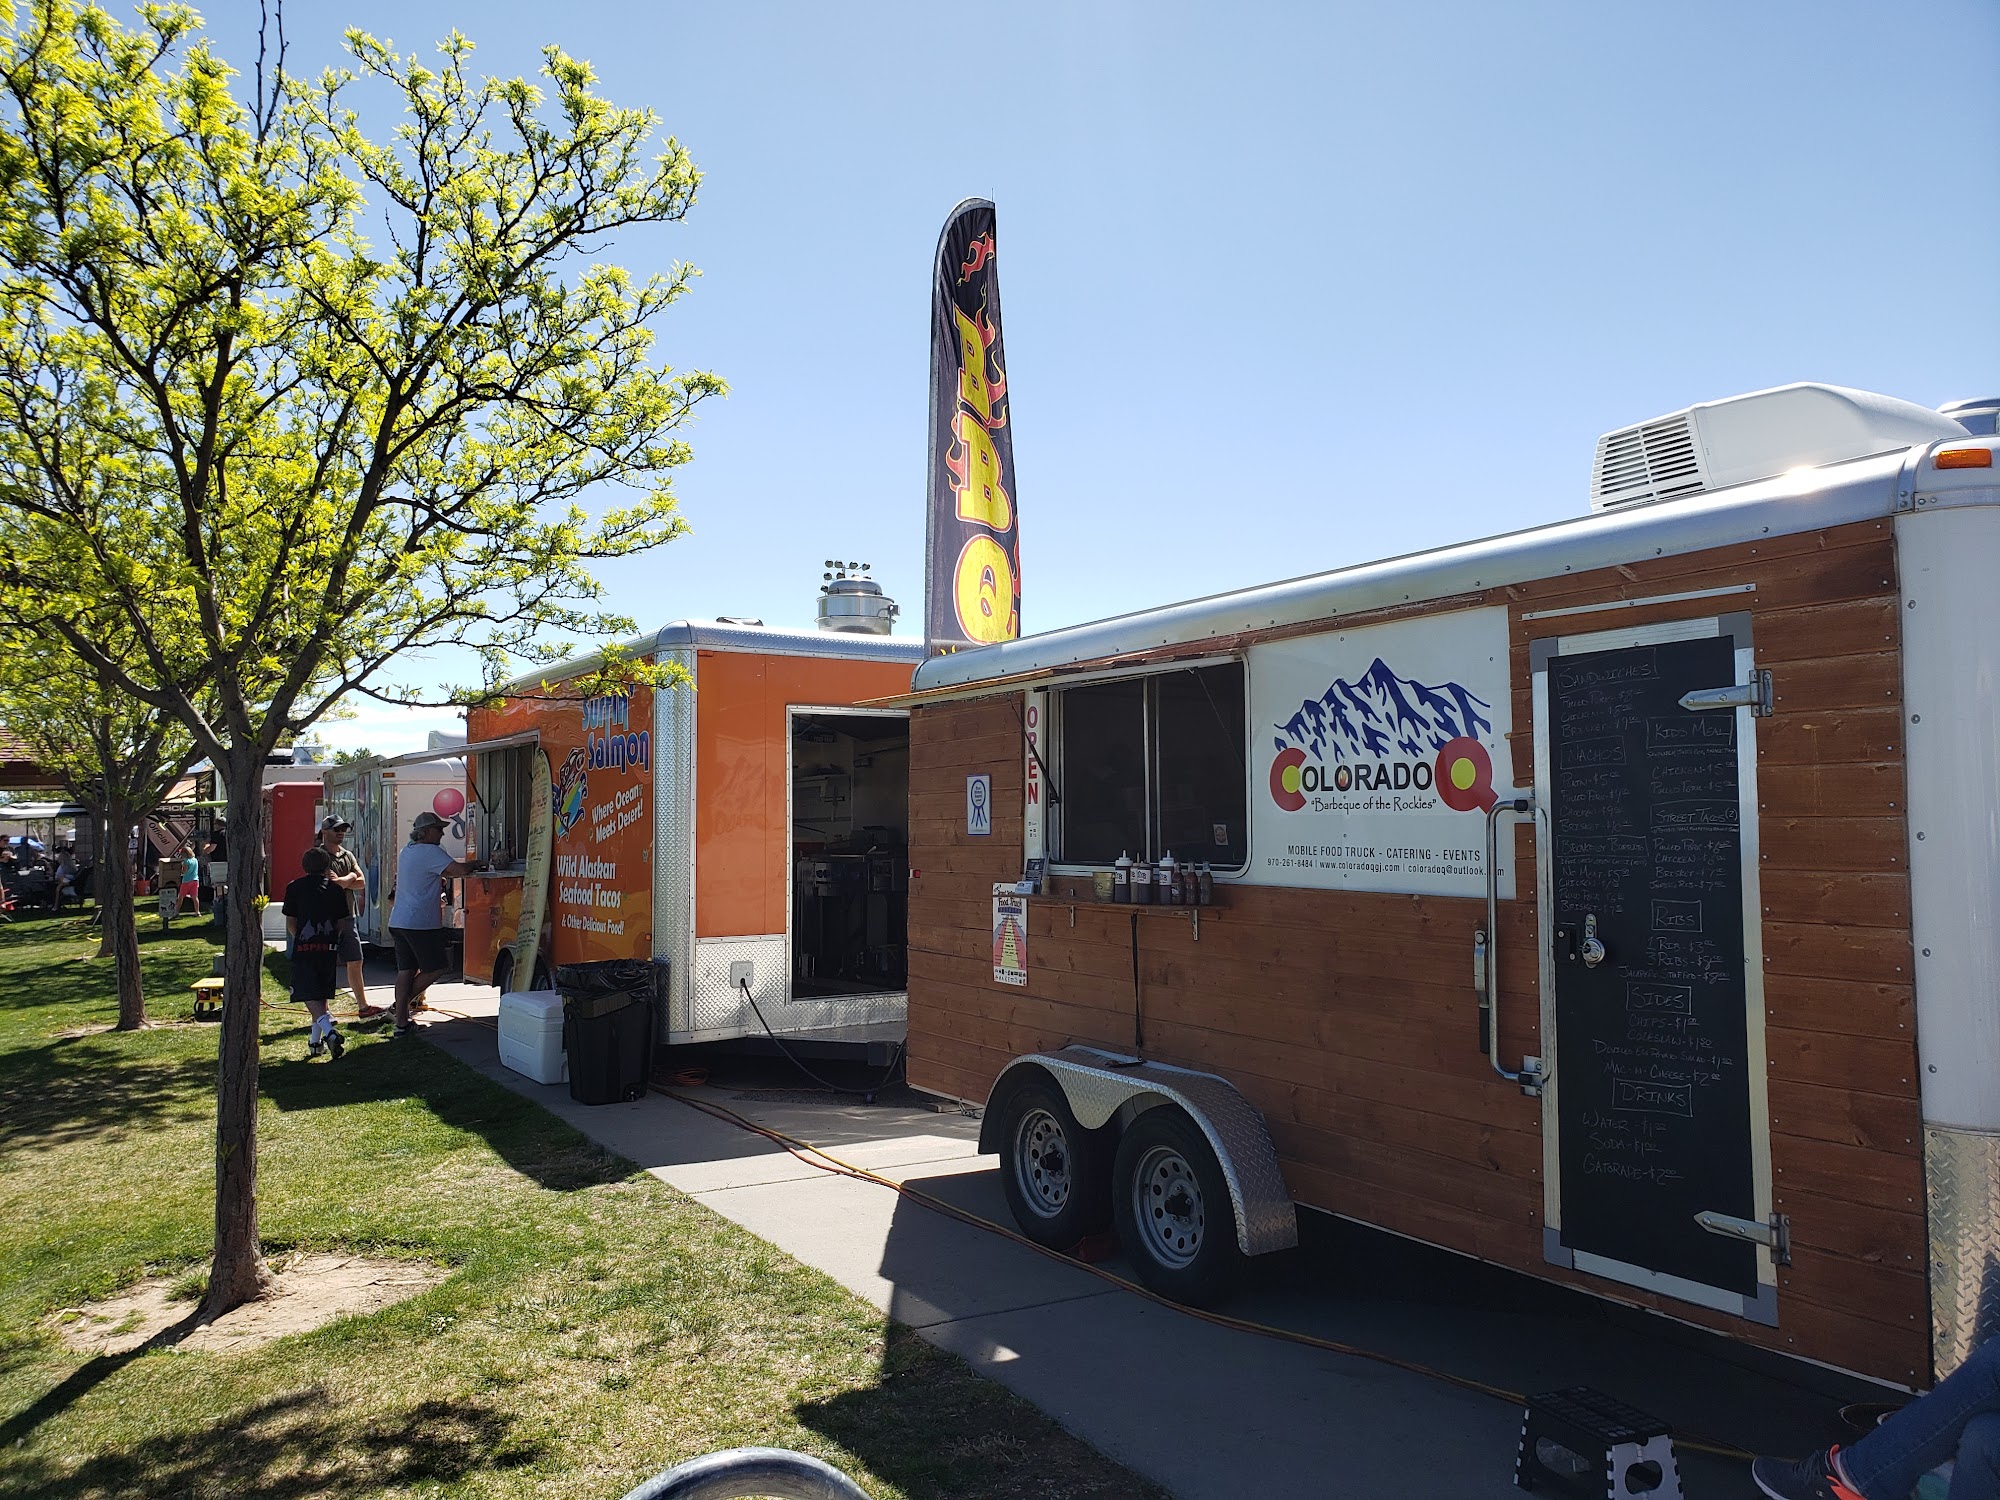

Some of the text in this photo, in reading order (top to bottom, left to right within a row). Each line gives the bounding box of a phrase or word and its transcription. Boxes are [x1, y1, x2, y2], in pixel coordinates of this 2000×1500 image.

[953, 302, 1018, 648] BBQ
[588, 730, 650, 775] Salmon
[1027, 706, 1038, 804] OPEN
[592, 784, 639, 826] Where Ocean
[1363, 797, 1375, 809] of
[1375, 798, 1391, 810] the
[596, 798, 643, 845] Meets Desert!
[148, 822, 171, 846] Official
[1287, 845, 1318, 856] MOBILE
[1320, 846, 1342, 857] FOOD
[1345, 847, 1375, 858] TRUCK
[1386, 848, 1431, 860] CATERING
[1443, 850, 1480, 861] EVENTS
[557, 855, 577, 877] Wild
[578, 855, 616, 880] Alaskan
[1408, 863, 1505, 877] coloradoq@outlook.m
[559, 881, 621, 909] Seafood Tacos
[561, 913, 625, 936] & Other Delicious Food!
[1656, 905, 1696, 927] RIBS
[1631, 986, 1684, 1009] SIDES
[1620, 1083, 1687, 1107] DRINKS
[1589, 1132, 1625, 1151] SODA
